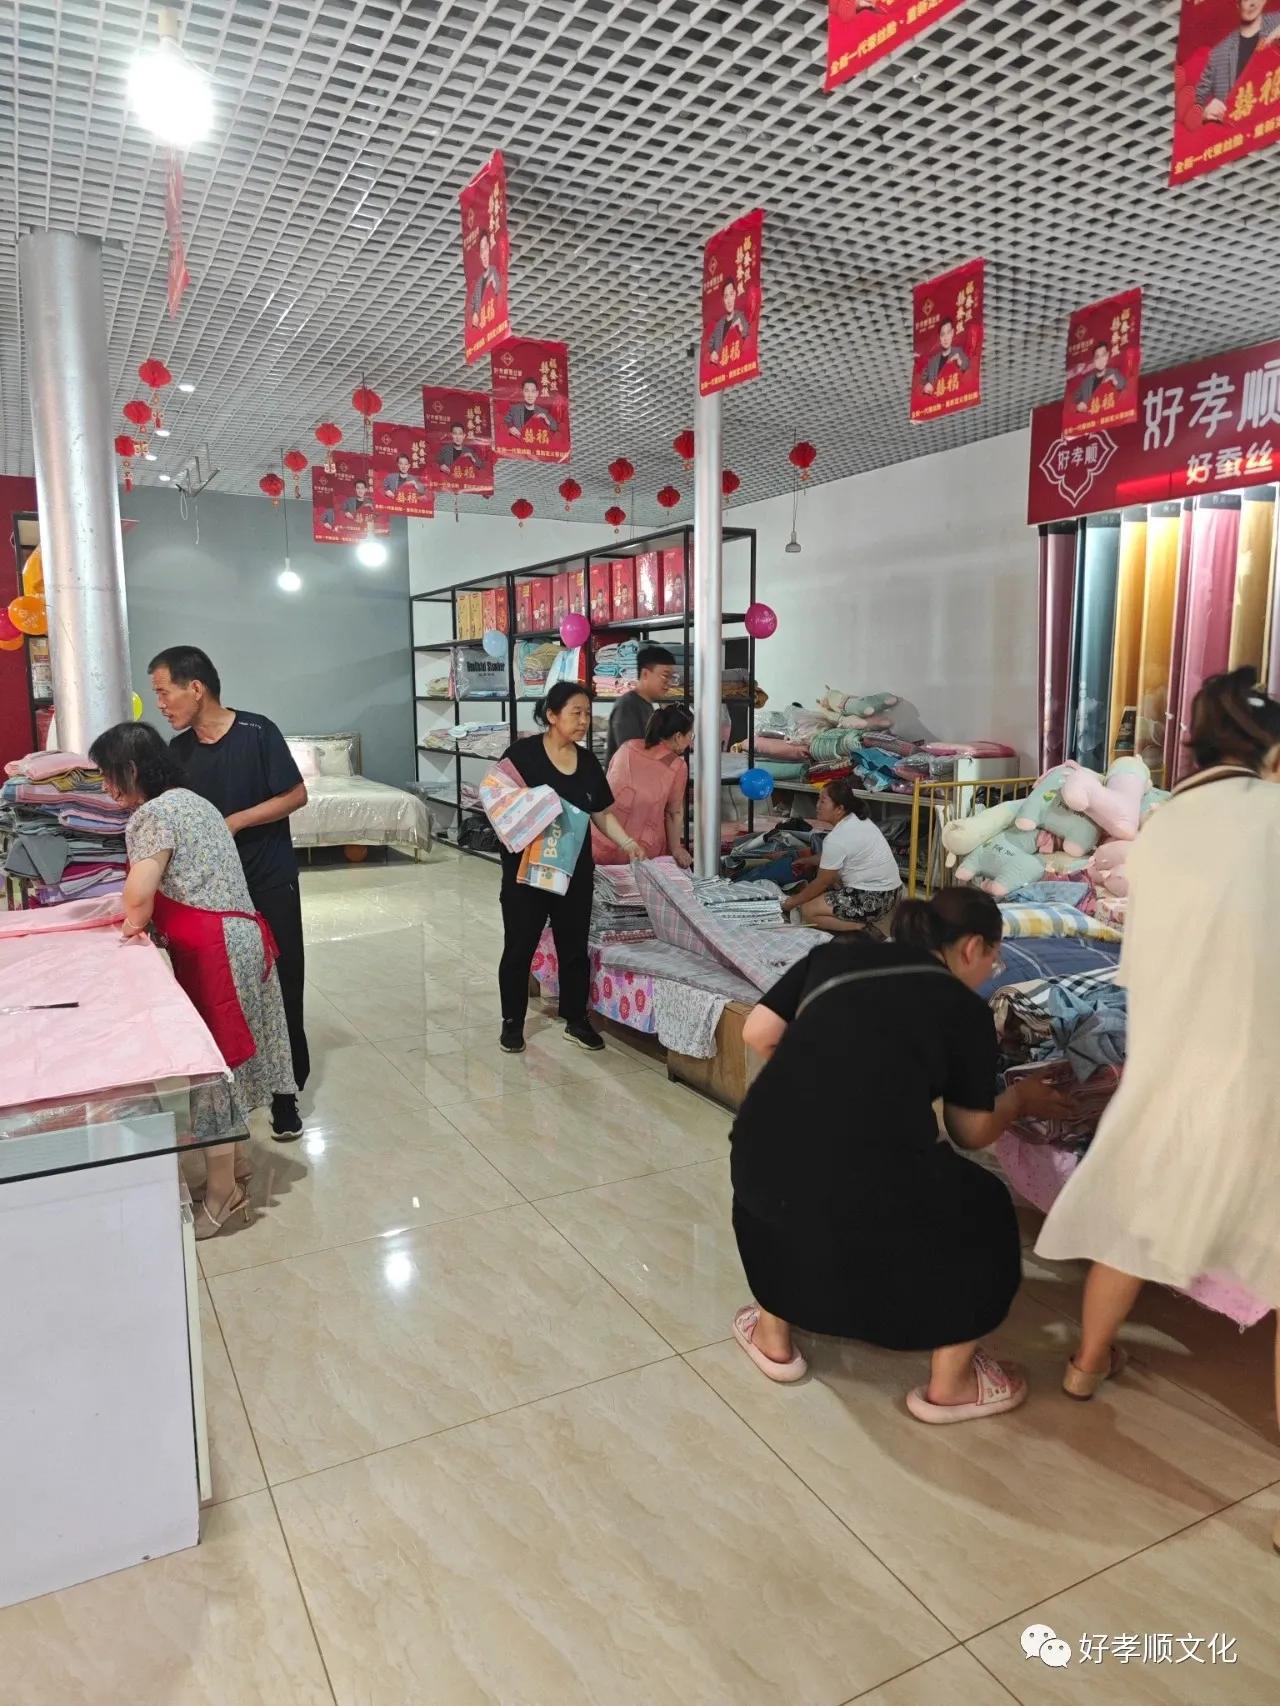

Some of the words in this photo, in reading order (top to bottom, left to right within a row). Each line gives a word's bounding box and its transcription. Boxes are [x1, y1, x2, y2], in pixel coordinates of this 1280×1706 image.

[1143, 358, 1280, 452] 好孝顺
[1057, 442, 1098, 472] 好孝顺
[1186, 439, 1274, 486] 好蚕丝
